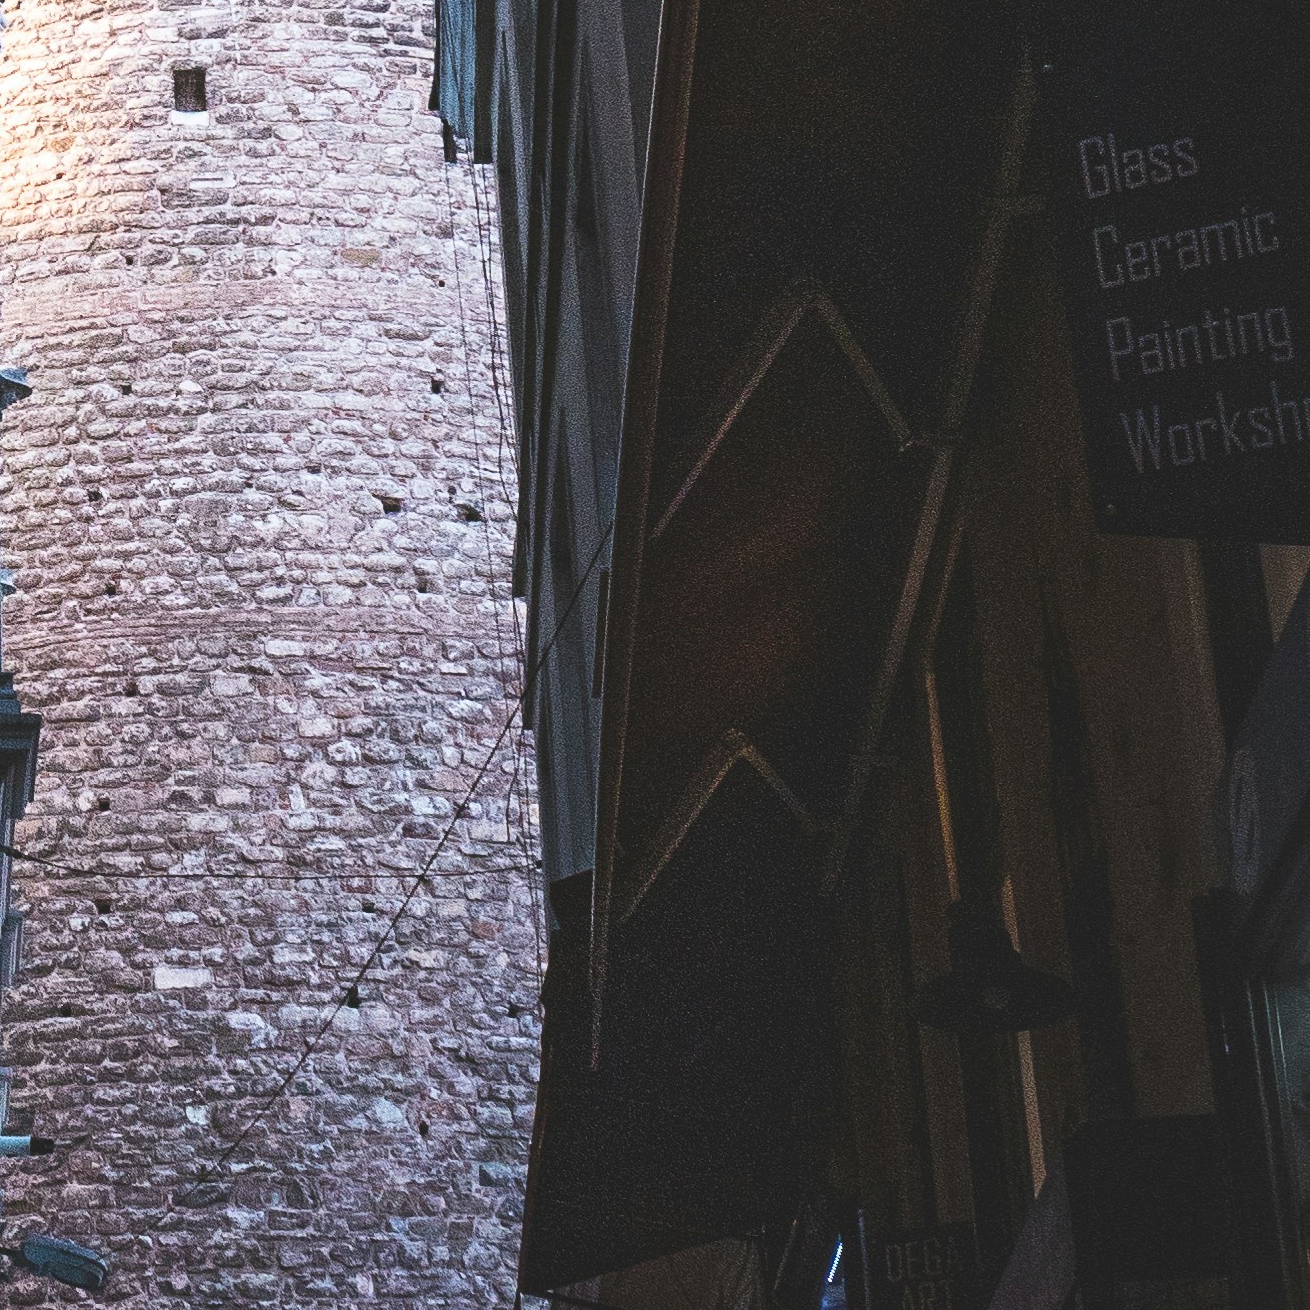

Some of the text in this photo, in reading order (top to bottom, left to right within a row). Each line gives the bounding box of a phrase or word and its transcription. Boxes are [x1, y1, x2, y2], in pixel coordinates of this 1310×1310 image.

[1078, 132, 1200, 199] Glass
[1092, 204, 1281, 289] Ceramic
[1105, 305, 1295, 382] Painting
[884, 1235, 965, 1284] DEGA
